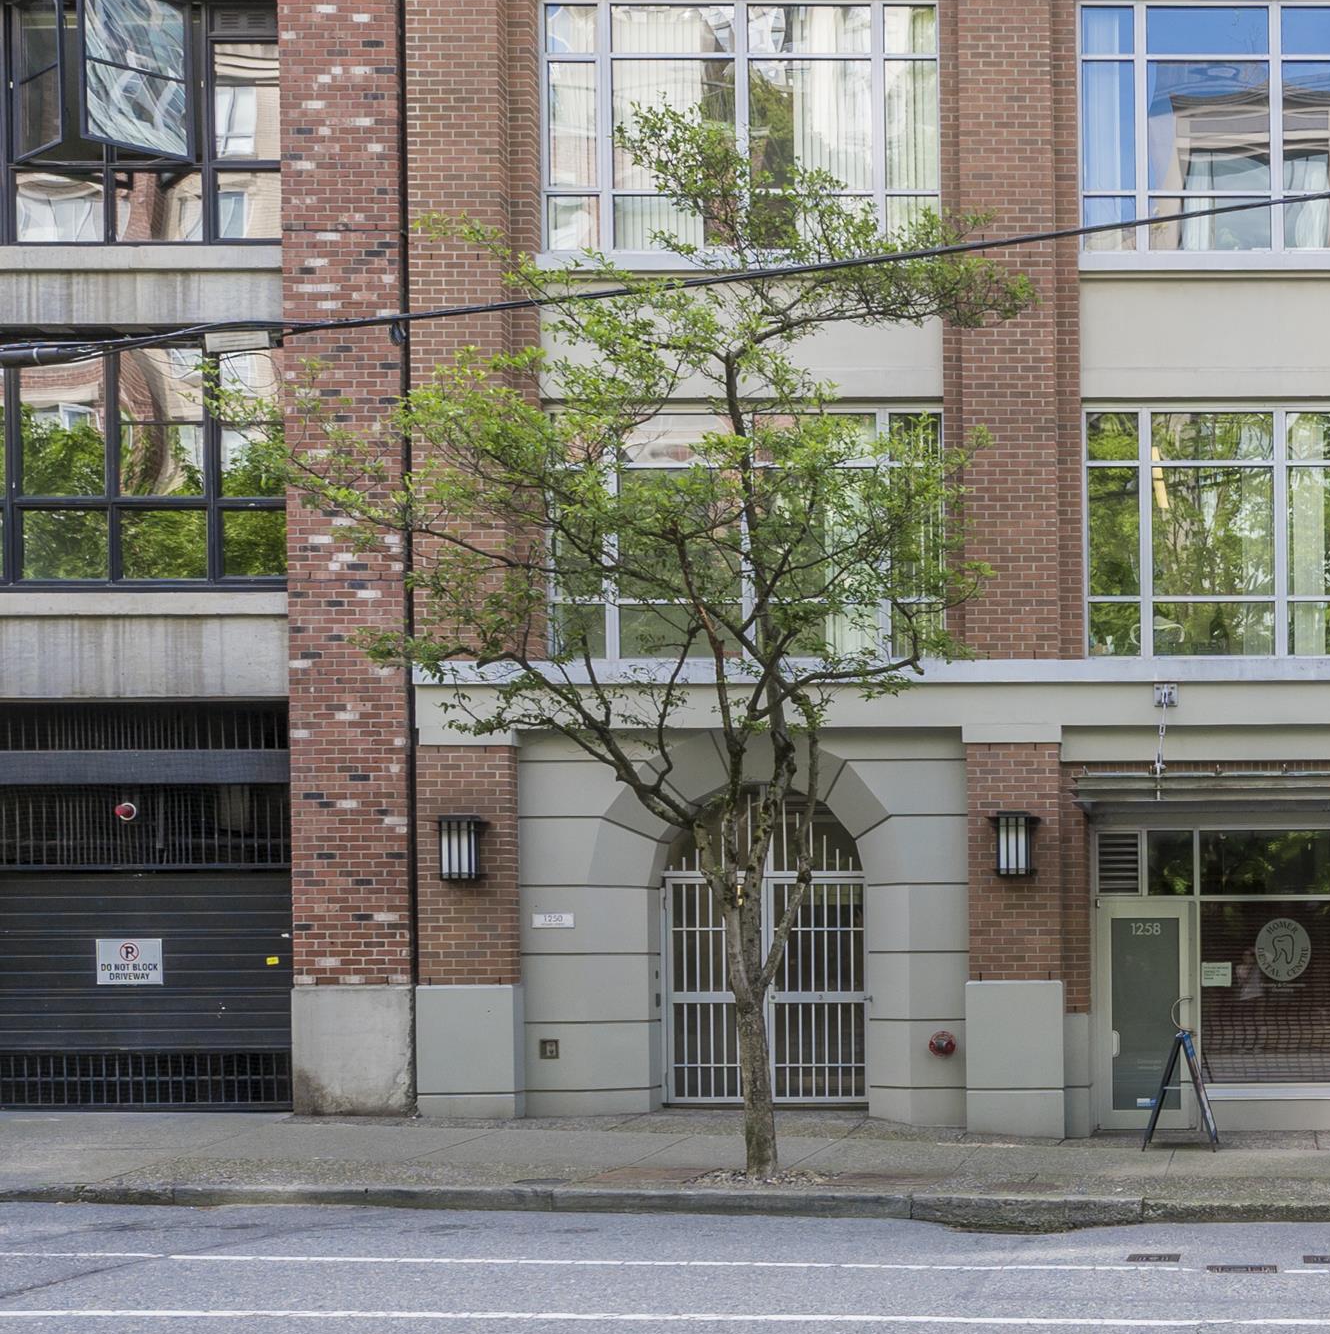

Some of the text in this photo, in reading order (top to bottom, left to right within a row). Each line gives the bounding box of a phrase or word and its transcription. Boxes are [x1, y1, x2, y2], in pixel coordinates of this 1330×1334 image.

[1130, 922, 1161, 936] 1258
[1266, 921, 1298, 934] HOMER
[101, 963, 158, 971] DO NOT BLOCK
[1257, 947, 1280, 977] DENTAL
[1287, 947, 1308, 977] CENTRE
[109, 972, 150, 981] DRIVEWAY
